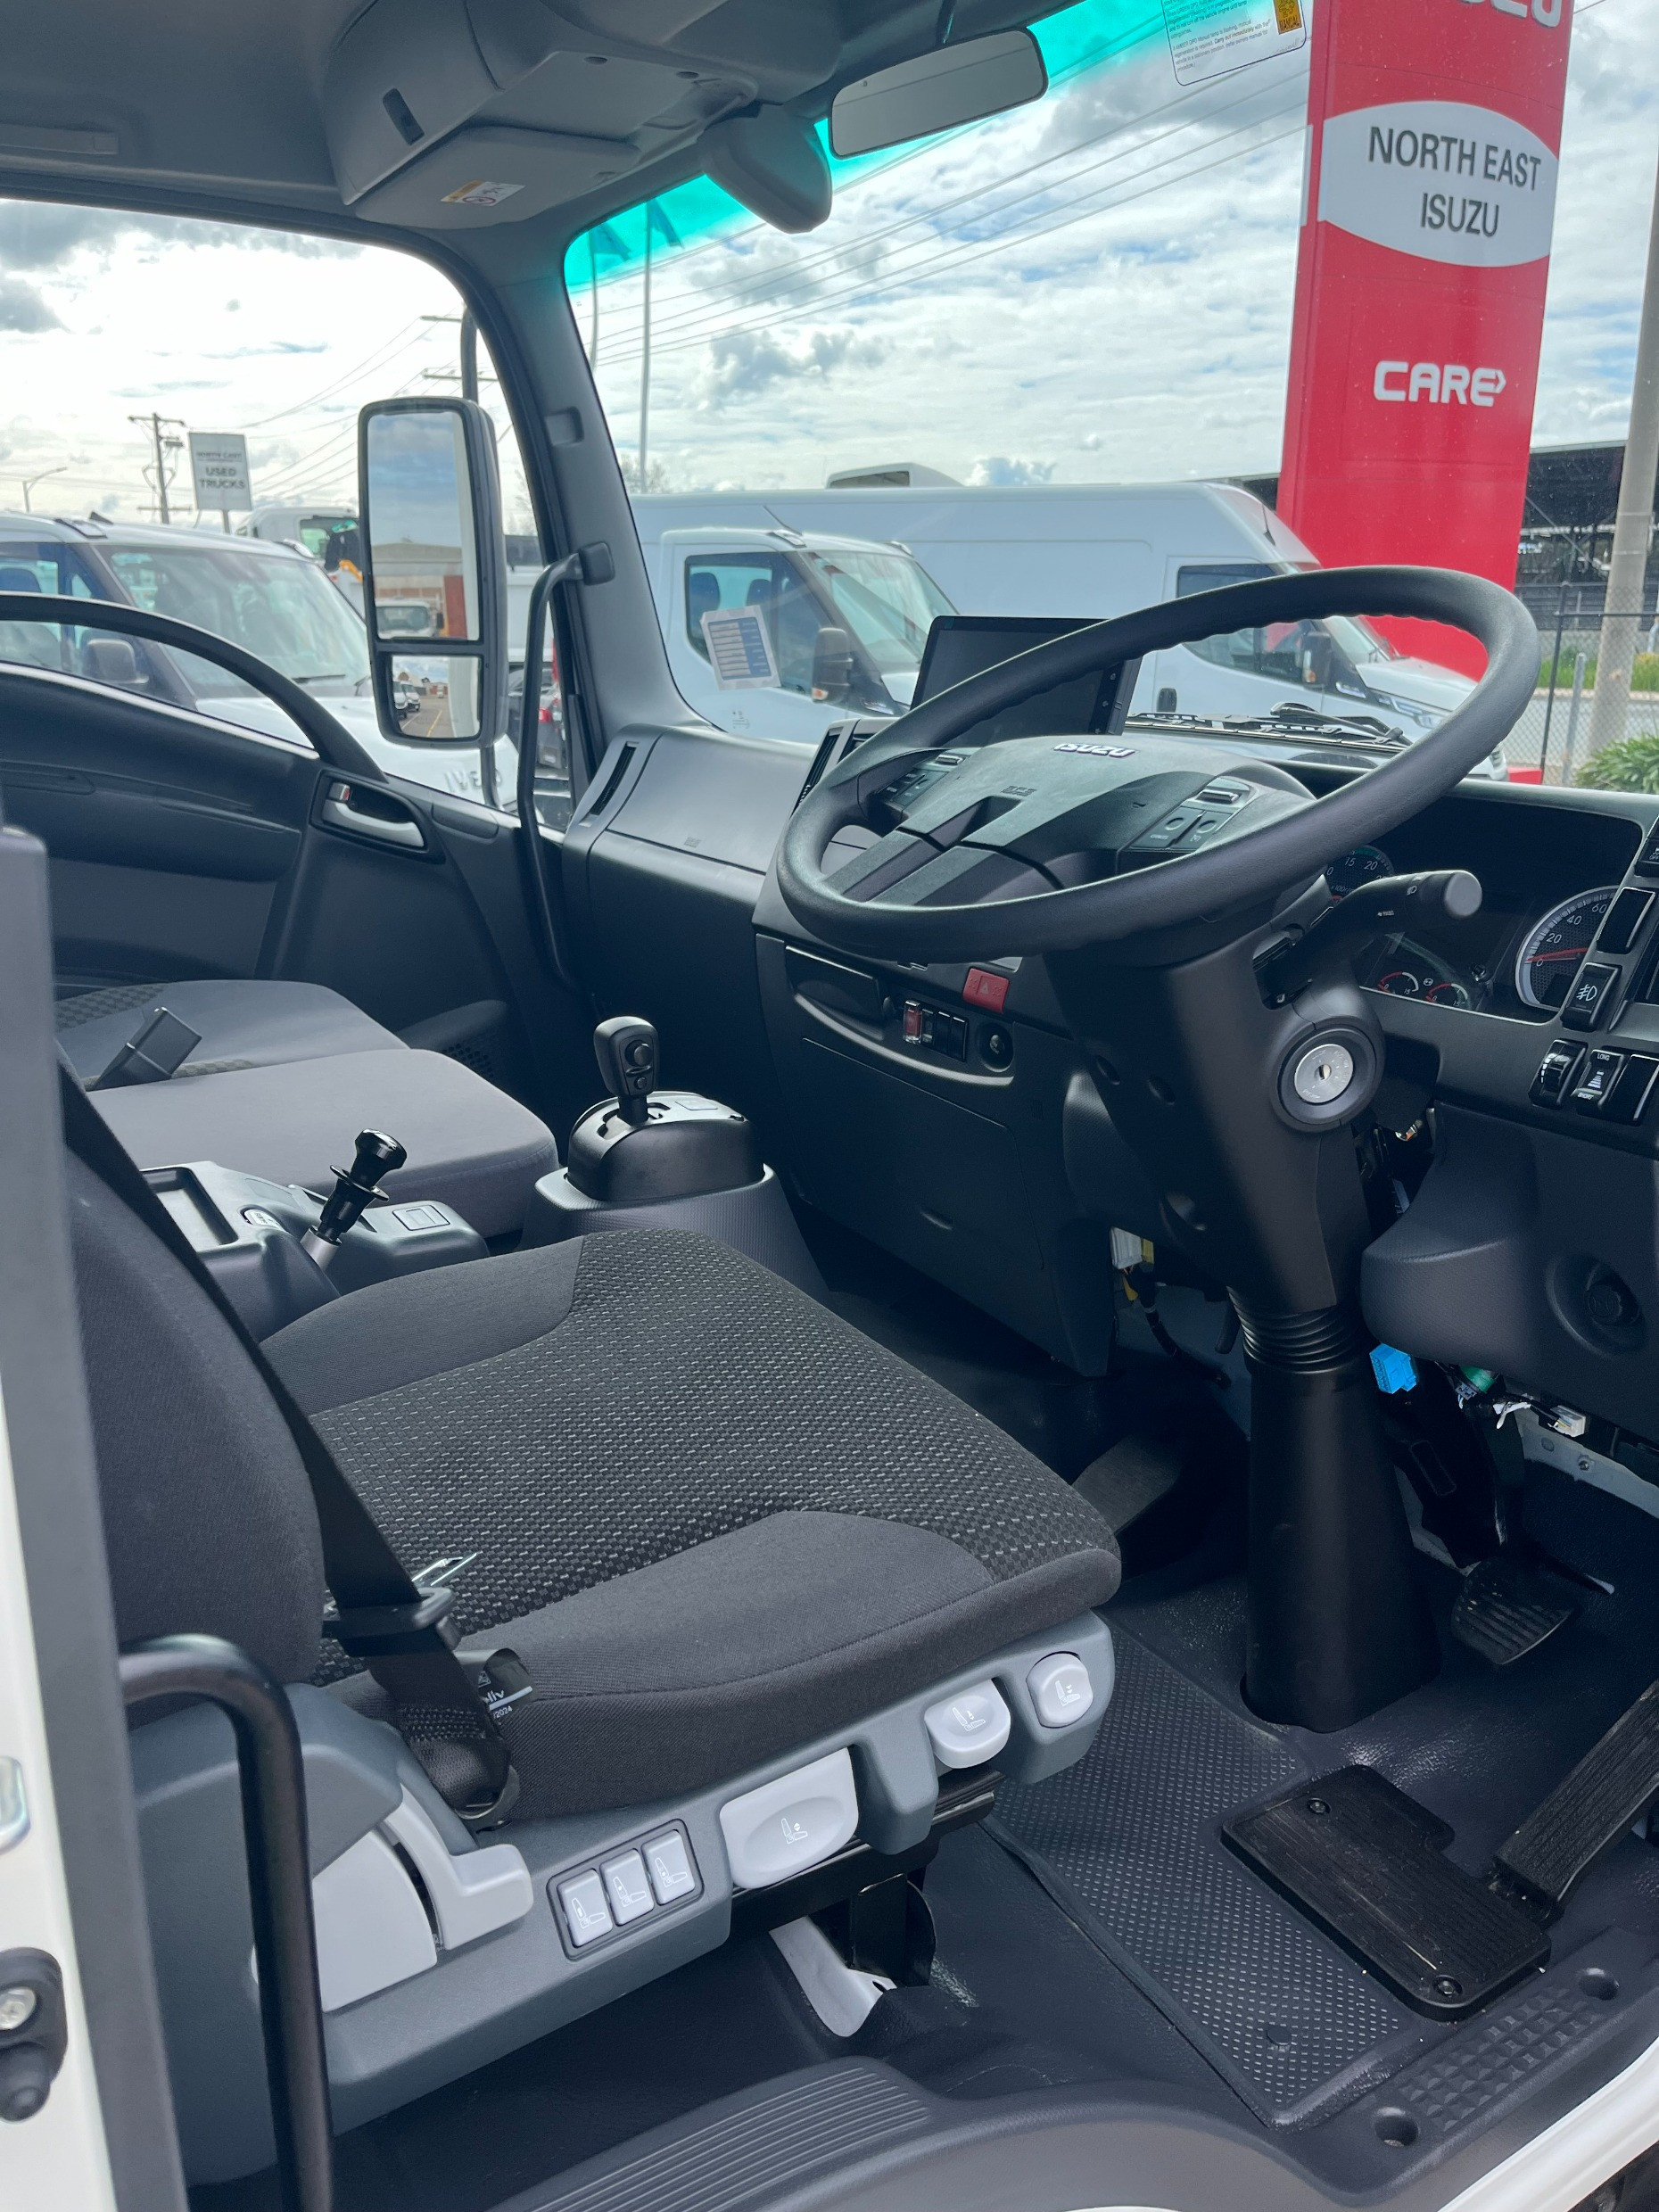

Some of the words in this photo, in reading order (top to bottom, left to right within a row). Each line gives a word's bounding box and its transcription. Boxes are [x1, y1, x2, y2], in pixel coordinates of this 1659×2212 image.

[1368, 126, 1477, 177] NORTH
[1482, 143, 1542, 191] EAST
[1420, 192, 1500, 237] ISUZU
[1374, 360, 1506, 408] CARE
[205, 466, 237, 477] USED
[200, 479, 246, 490] TRUCKS
[1052, 742, 1136, 758] ISUZU
[1344, 856, 1357, 867] 15
[1364, 860, 1378, 871] 20
[1591, 903, 1607, 914] 60
[1566, 915, 1582, 926] 40
[1546, 932, 1563, 944] 20
[1597, 1052, 1611, 1062] LONG
[1577, 1092, 1595, 1101] SHORT
